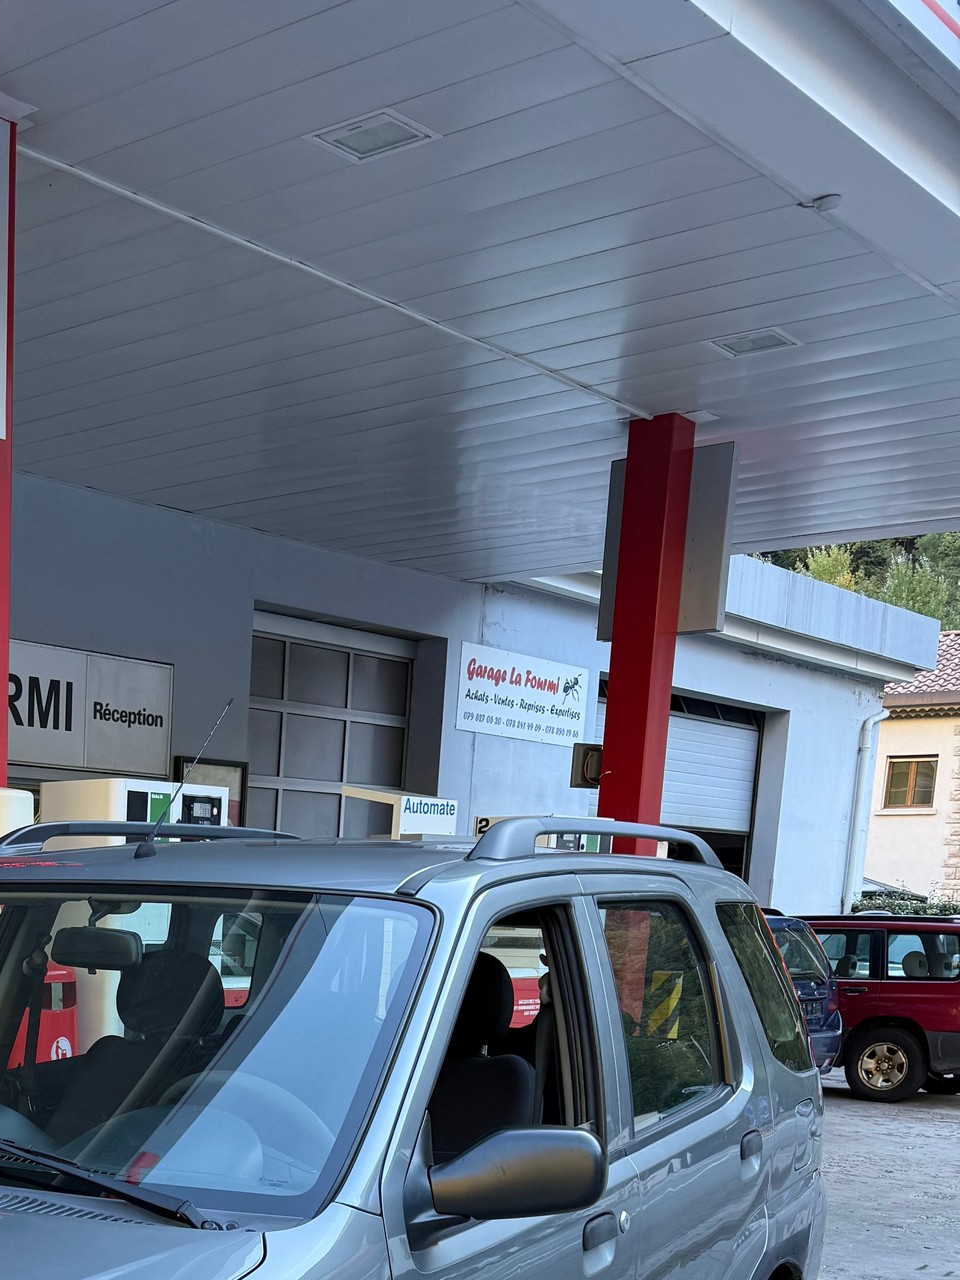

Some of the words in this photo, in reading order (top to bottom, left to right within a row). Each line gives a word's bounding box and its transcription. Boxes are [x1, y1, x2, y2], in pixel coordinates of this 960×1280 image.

[467, 658, 507, 687] Garage
[509, 667, 522, 686] La
[93, 701, 164, 728] Réception
[465, 688, 489, 704] Achats
[494, 693, 514, 709] Ventes
[519, 698, 545, 715] Reprises
[550, 704, 580, 720] Expertises
[403, 797, 456, 816] Automate
[478, 818, 490, 834] 2
